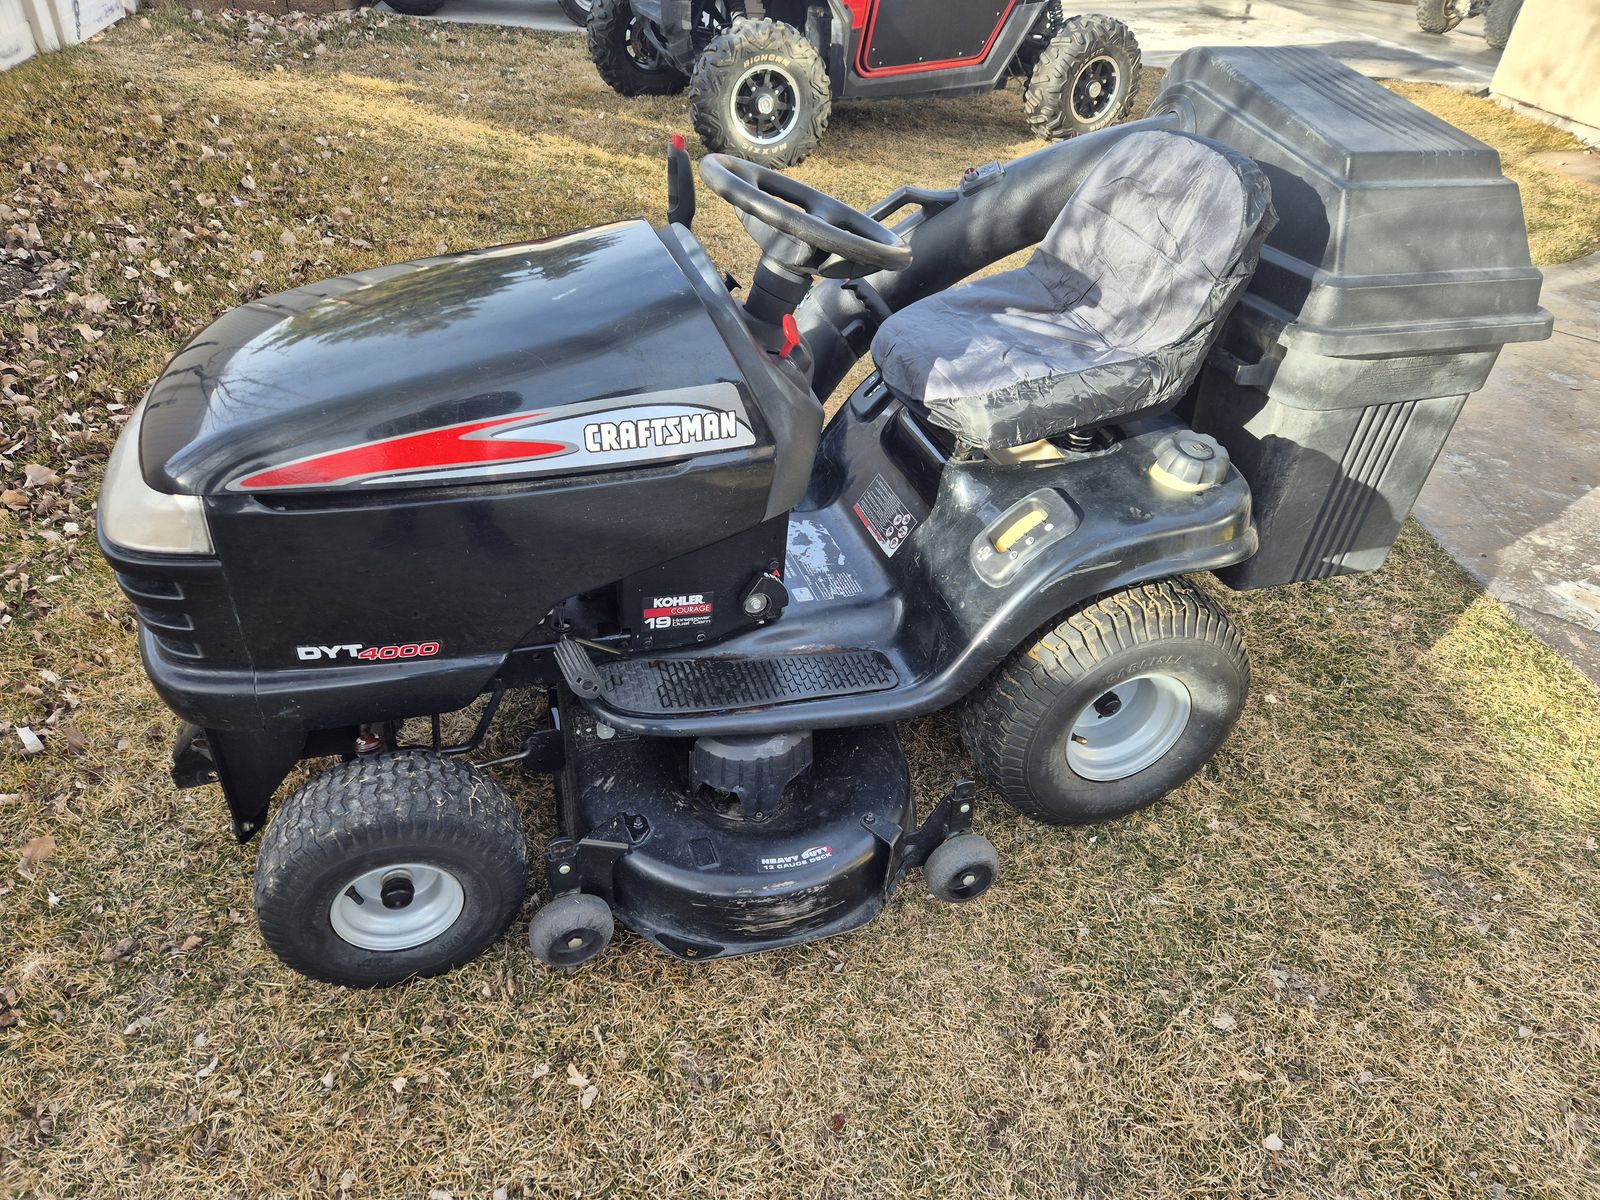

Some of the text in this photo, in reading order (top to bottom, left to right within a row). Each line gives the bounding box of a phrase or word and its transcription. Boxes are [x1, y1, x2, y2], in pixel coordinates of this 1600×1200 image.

[743, 53, 791, 68] BIGHORN
[742, 142, 788, 155] MAXXIS
[583, 410, 737, 453] CRAFTSMAN
[653, 594, 704, 608] KOHLER
[670, 604, 711, 615] COURAGE
[644, 616, 672, 629] 19
[761, 846, 829, 865] HEAVY DUTY
[776, 860, 808, 870] GAUGE
[809, 851, 832, 864] DECK
